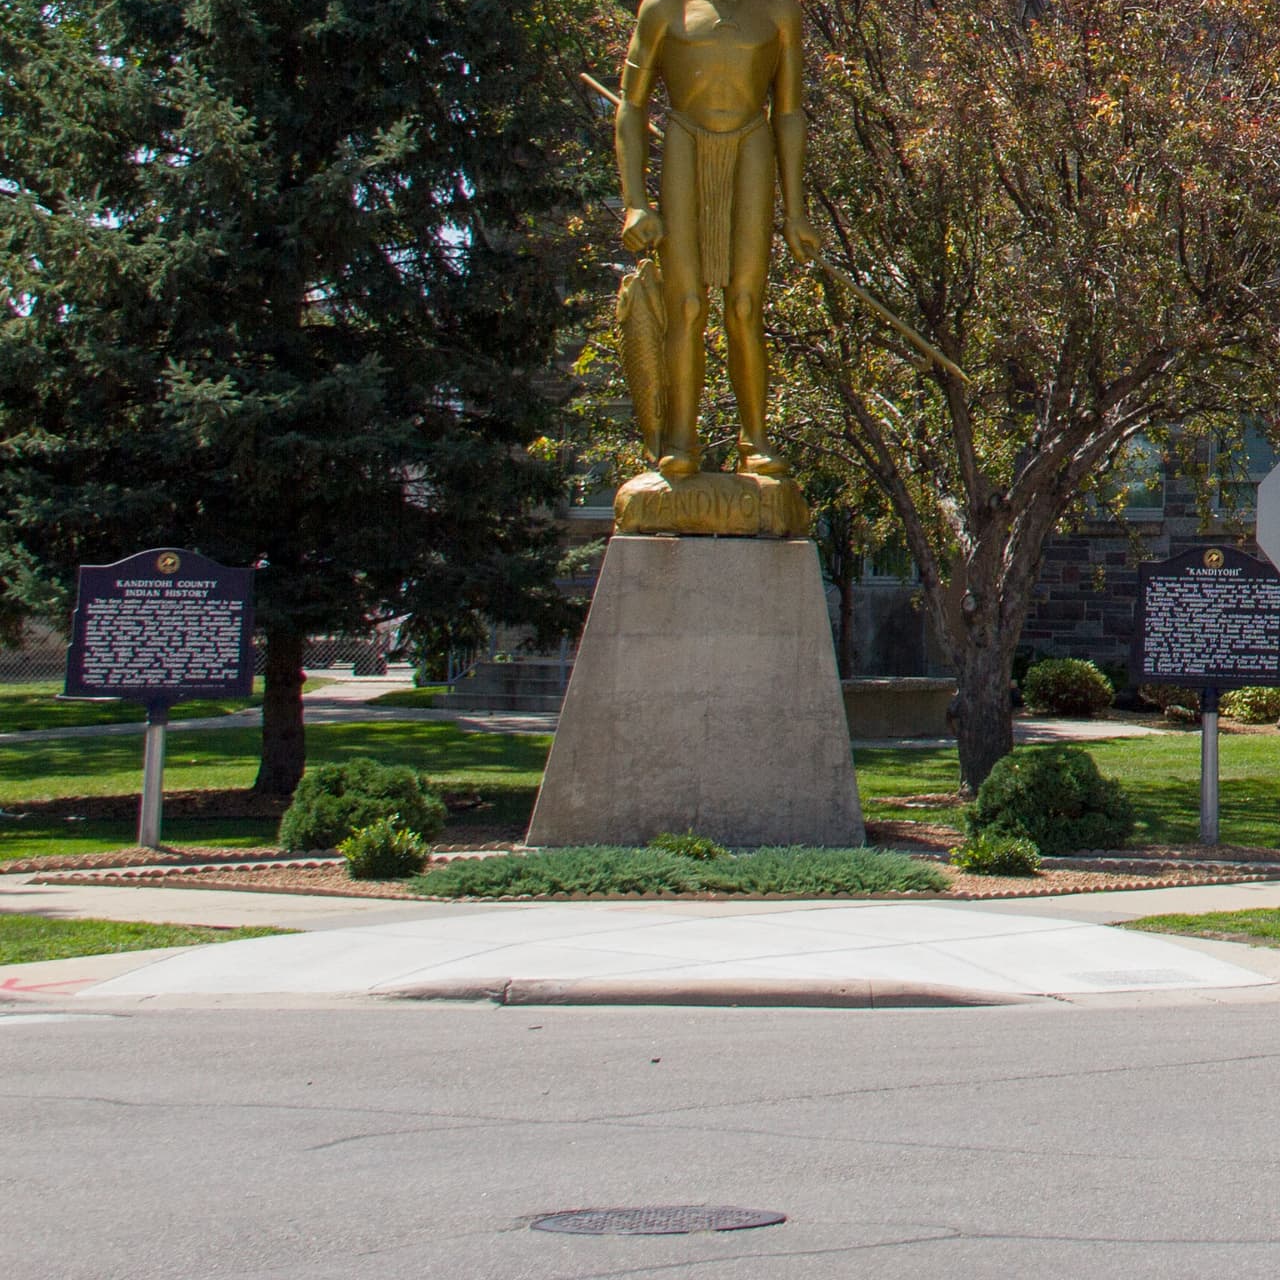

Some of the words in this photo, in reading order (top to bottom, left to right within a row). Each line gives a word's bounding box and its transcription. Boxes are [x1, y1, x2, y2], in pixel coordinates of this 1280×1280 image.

[642, 487, 784, 520] KANDIYOHI
[116, 580, 173, 588] KANDIYOHI
[177, 581, 217, 589] COUNTY
[125, 589, 161, 597] INDIAN
[165, 589, 209, 598] HISTORY
